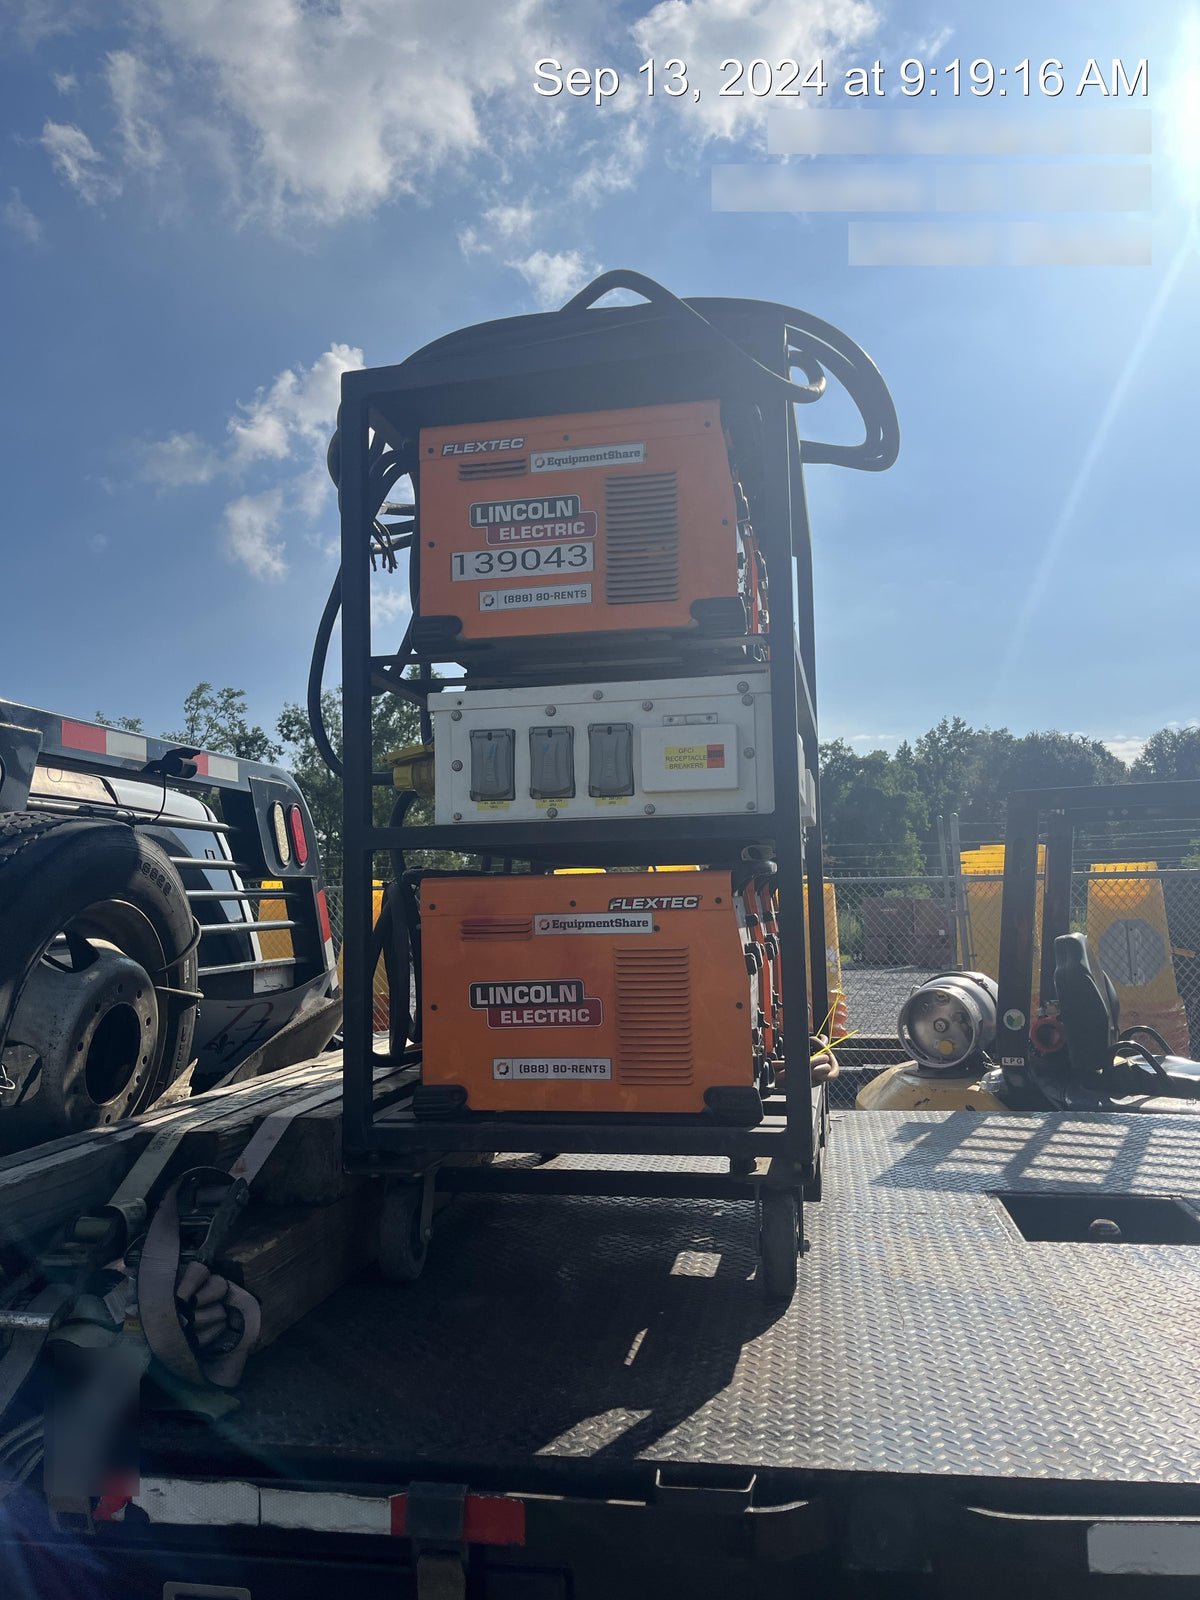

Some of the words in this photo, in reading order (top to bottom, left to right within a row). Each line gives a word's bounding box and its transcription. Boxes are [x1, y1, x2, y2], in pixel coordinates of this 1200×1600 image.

[441, 438, 524, 456] FLEXTEC
[547, 450, 641, 466] EquipmentShare
[475, 499, 574, 524] LINCOLN
[499, 521, 586, 541] ELECTRIC
[453, 544, 589, 576] 139043
[503, 594, 533, 604] (888)
[609, 896, 698, 910] FLEXTEC
[552, 918, 649, 931] EquipmentShare
[475, 985, 578, 1006] LINCOLN
[500, 1008, 590, 1025] ELECTRIC
[518, 1063, 549, 1074] (888)
